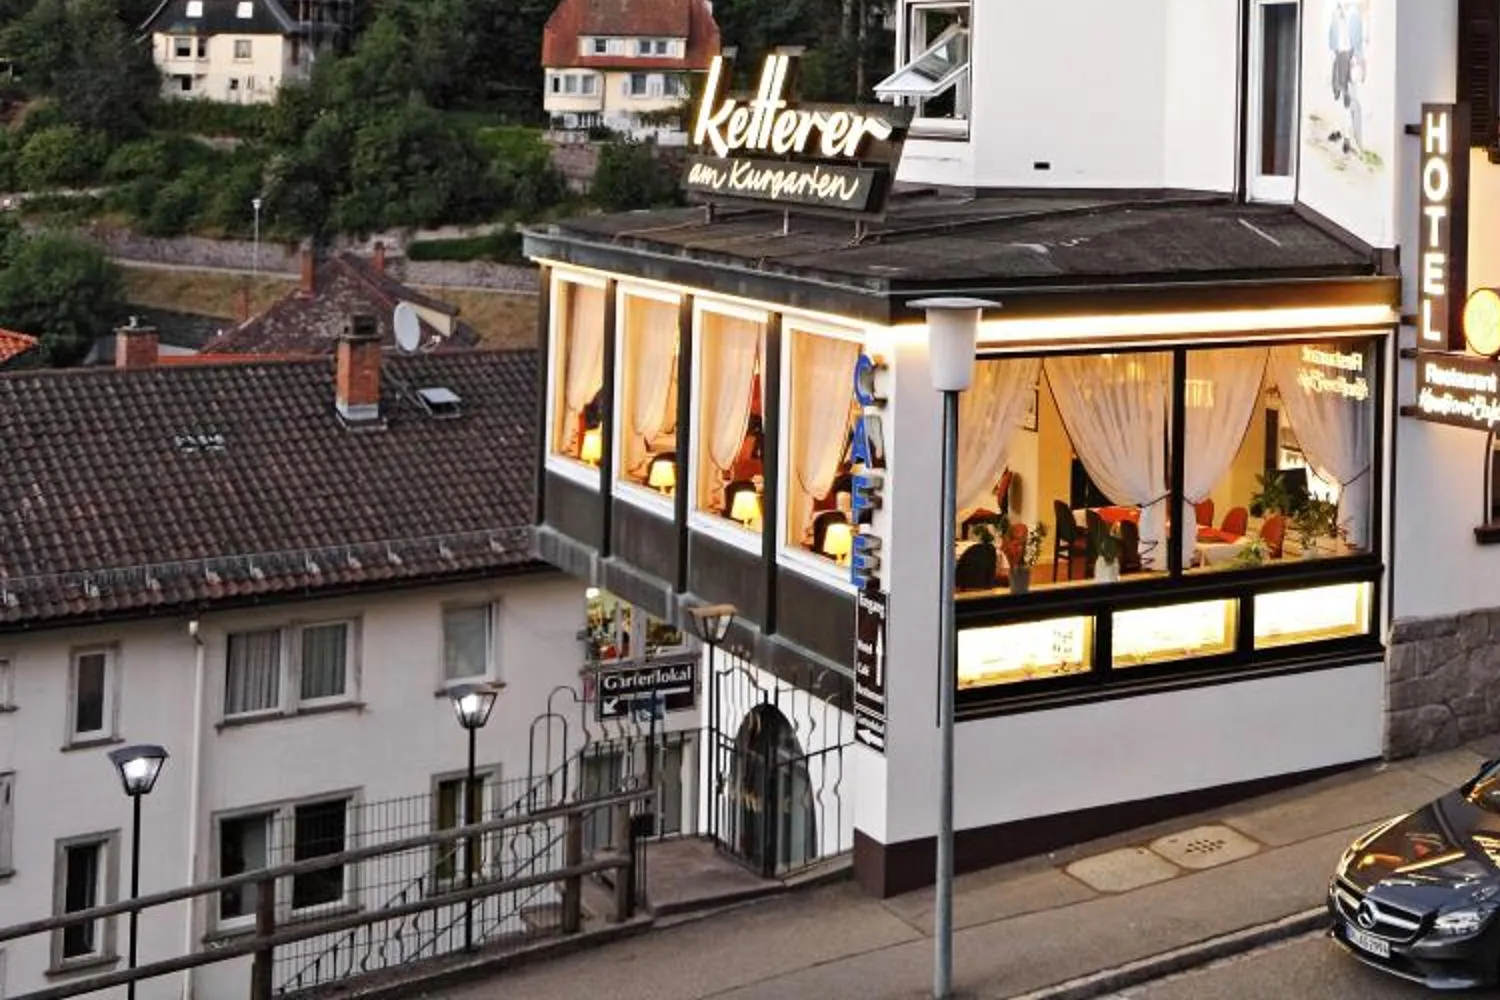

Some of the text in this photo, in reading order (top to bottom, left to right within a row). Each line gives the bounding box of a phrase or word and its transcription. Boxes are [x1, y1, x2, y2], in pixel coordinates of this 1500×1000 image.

[688, 159, 859, 201] am Kurgarten
[1423, 112, 1449, 342] HOTEL
